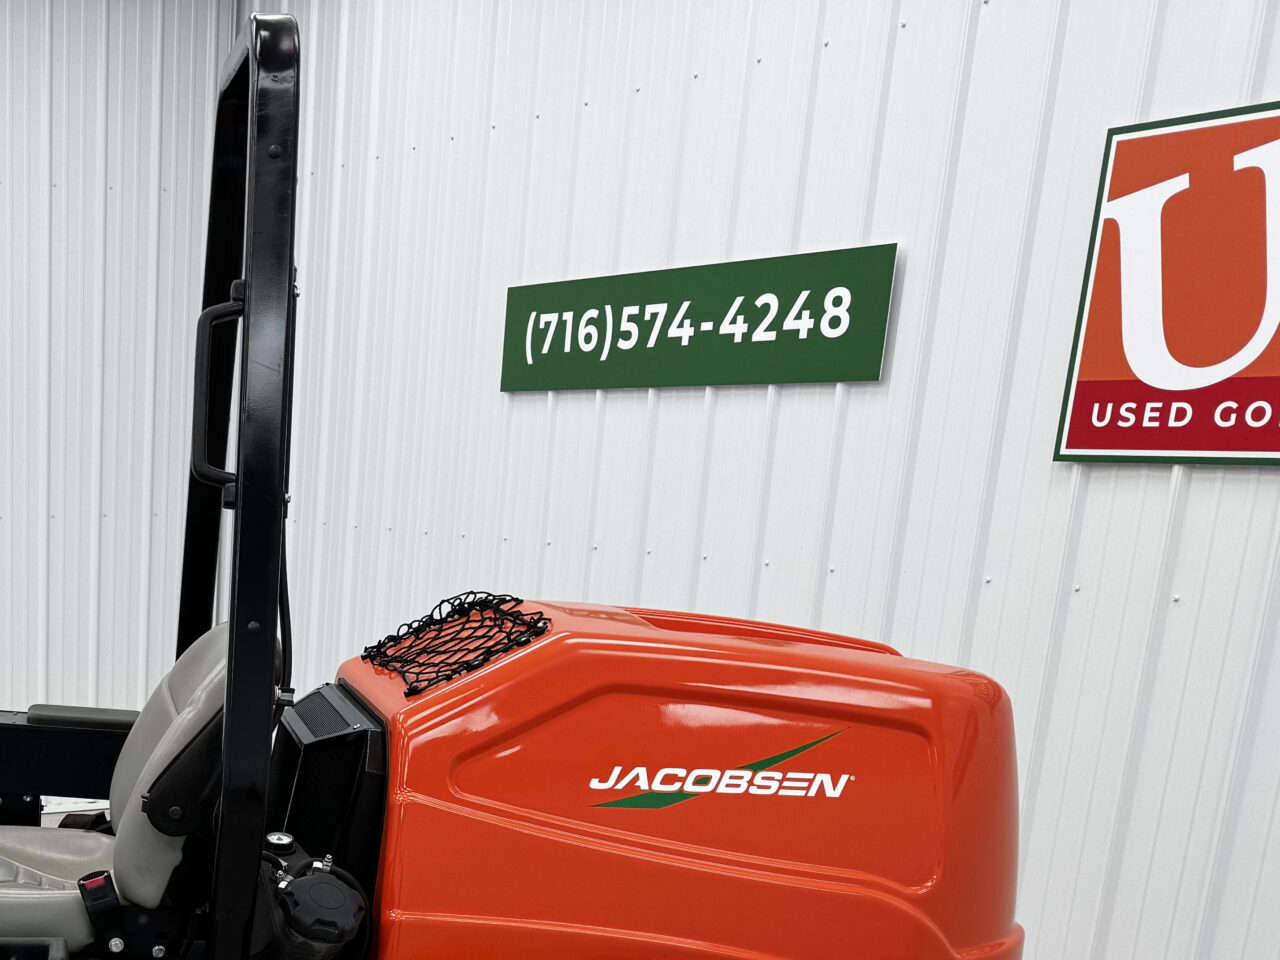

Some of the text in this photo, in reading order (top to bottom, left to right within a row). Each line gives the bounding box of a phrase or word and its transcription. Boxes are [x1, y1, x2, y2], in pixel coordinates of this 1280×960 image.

[524, 286, 852, 365] (716)574-4248
[1090, 400, 1280, 428] USED GO
[589, 766, 850, 798] JACOBSEN
